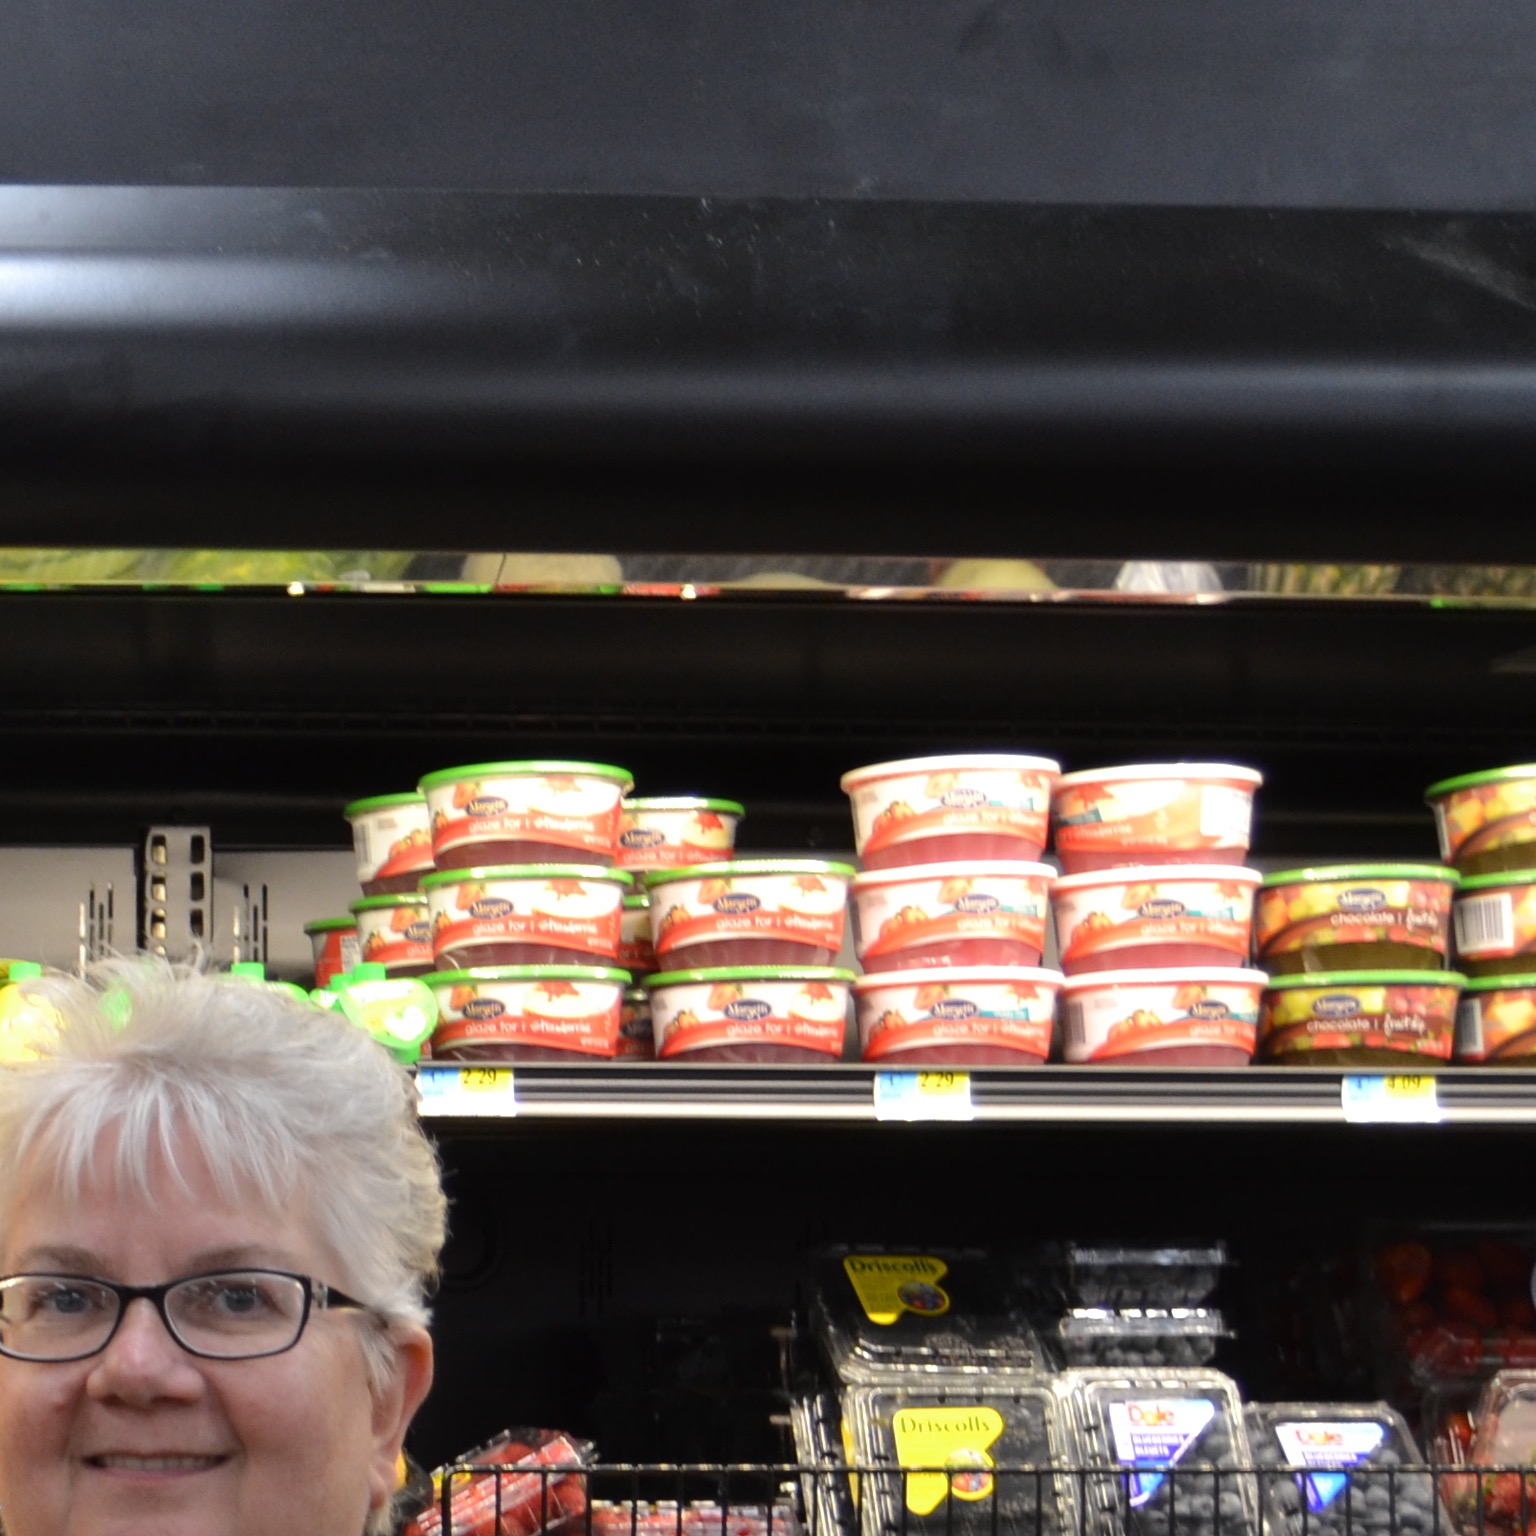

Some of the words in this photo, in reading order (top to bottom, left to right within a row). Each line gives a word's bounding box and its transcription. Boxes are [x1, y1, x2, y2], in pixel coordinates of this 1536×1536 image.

[503, 815, 521, 829] for
[507, 918, 525, 931] for
[752, 914, 770, 929] for
[1330, 912, 1394, 927] chocolate
[501, 1019, 519, 1034] for
[763, 1020, 782, 1035] for
[1306, 1018, 1370, 1032] chocolate
[1127, 1403, 1175, 1425] Dole
[1295, 1429, 1343, 1445] Dole
